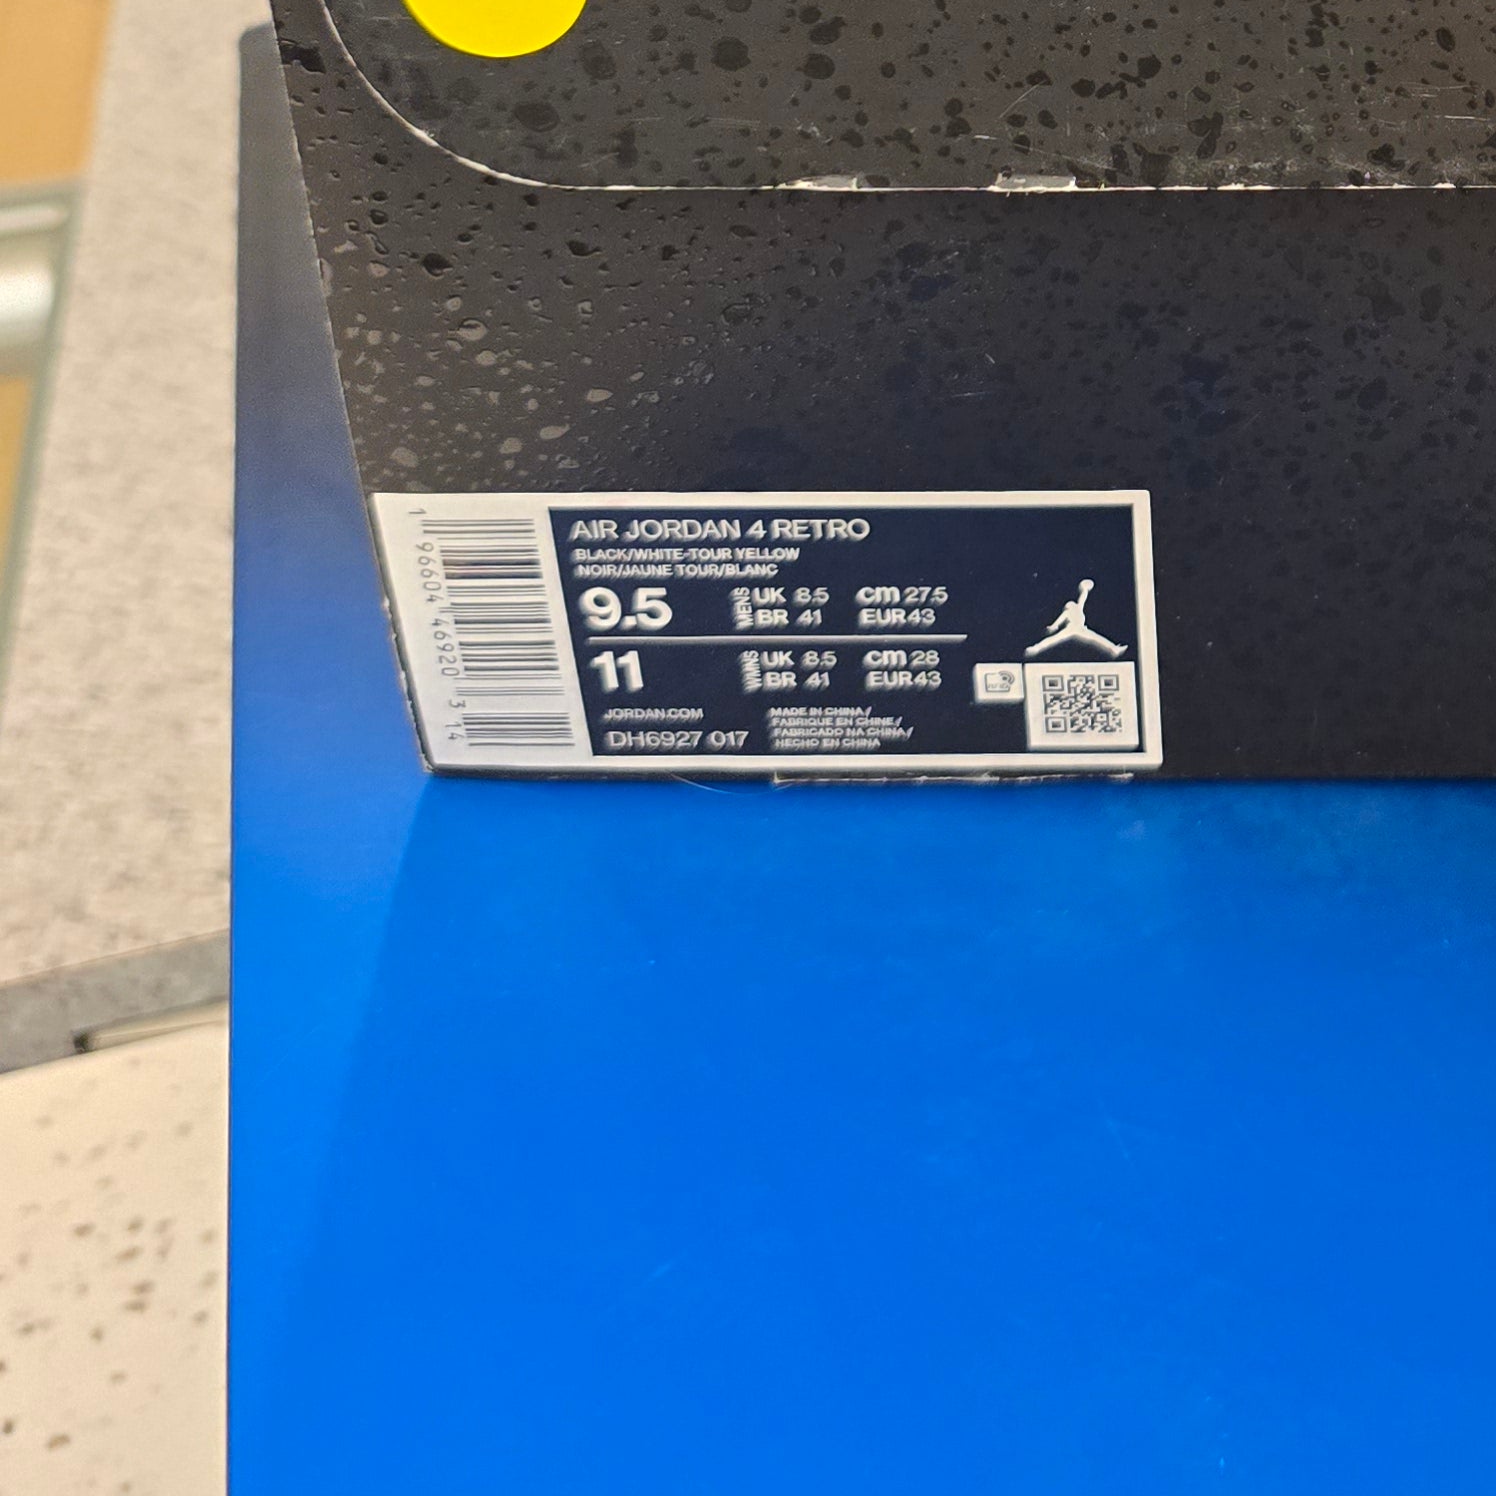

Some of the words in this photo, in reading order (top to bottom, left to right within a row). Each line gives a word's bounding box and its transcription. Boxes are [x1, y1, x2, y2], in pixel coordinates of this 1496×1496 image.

[570, 519, 618, 540] AIR
[626, 519, 741, 540] JORDAN
[745, 519, 768, 540] 4
[770, 518, 871, 540] RETRO
[575, 548, 732, 562] BLACK/WHITE-TOUR
[734, 547, 800, 561] YELLOW
[577, 564, 673, 577] NOIR/JAUNE
[674, 564, 780, 577] TOUR/BLANC
[753, 587, 787, 604] UK
[856, 586, 900, 604] cm
[415, 542, 443, 603] 96604
[432, 617, 460, 678] 46920
[580, 586, 673, 631] 9.5
[731, 587, 754, 630] MENS
[755, 609, 789, 627] BR
[795, 609, 823, 626] 41
[760, 650, 795, 668] UK
[863, 650, 907, 668] cm
[909, 650, 940, 668] 28
[590, 651, 644, 692] 11
[763, 671, 797, 690] BR
[802, 671, 830, 689] 41
[603, 708, 704, 720] JORDAN.COM
[769, 707, 807, 716] MADE
[809, 707, 823, 716] IN
[770, 717, 833, 726] FABRIQUE
[835, 717, 853, 726] EN
[606, 731, 703, 748] DH6927
[707, 730, 749, 748] 017
[772, 727, 844, 737] FABRICADO
[846, 727, 864, 737] NA
[774, 738, 820, 749] HECHO
[822, 738, 840, 749] EN
[842, 738, 881, 748] CHINA
